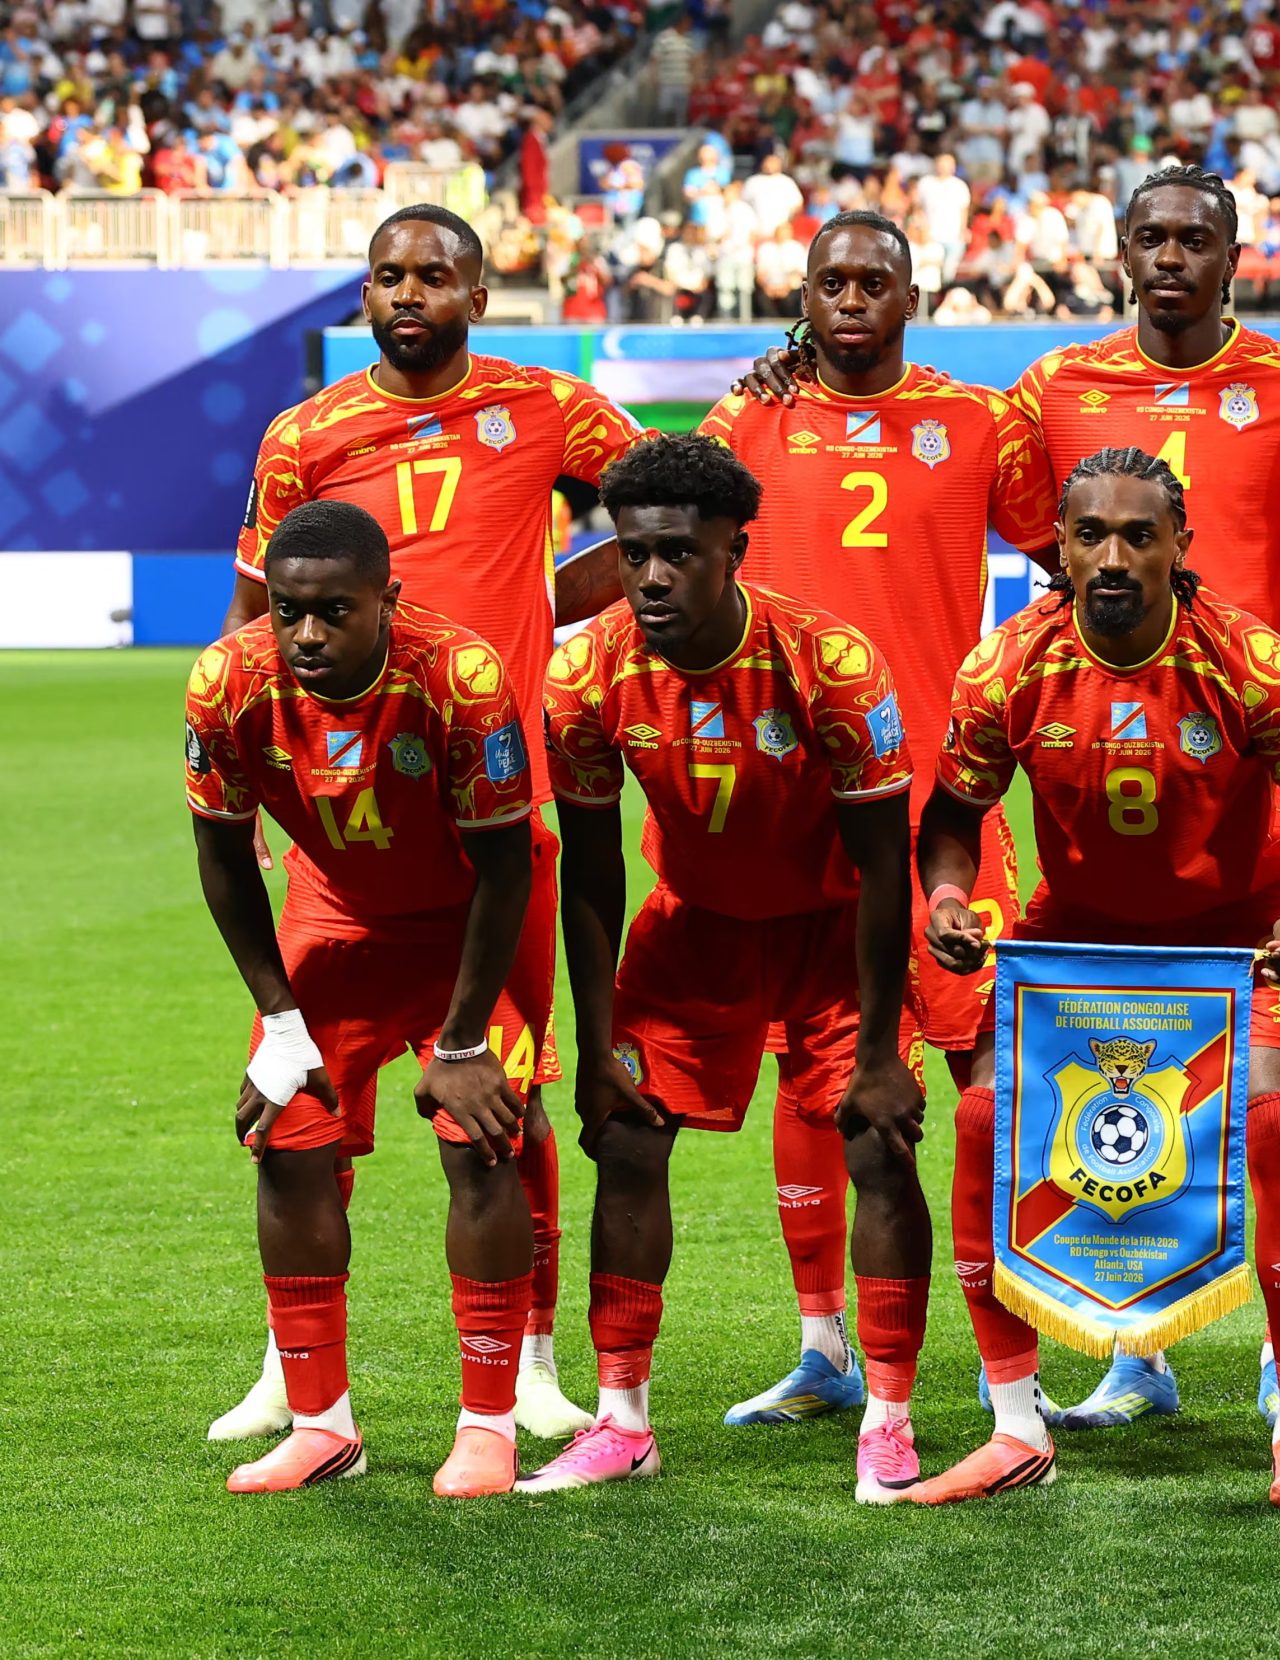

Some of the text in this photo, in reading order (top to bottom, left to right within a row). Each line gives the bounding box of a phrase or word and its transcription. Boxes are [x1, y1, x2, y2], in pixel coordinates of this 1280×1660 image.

[347, 446, 376, 456] umbro
[1155, 431, 1191, 490] 4
[396, 456, 461, 536] 17
[840, 471, 888, 548] 2
[628, 740, 658, 750] umbro
[764, 743, 790, 752] FECOFA
[1041, 740, 1073, 748] umbro
[1188, 745, 1216, 755] FECOFA
[266, 760, 291, 771] umbro
[688, 764, 736, 833] 7
[1106, 767, 1159, 835] 8
[315, 787, 394, 850] 14
[1059, 998, 1189, 1015] FÉDÉRATION CONGOLAISE
[1055, 1016, 1192, 1031] DE FOOTBALL ASSOCIATION
[489, 1023, 535, 1093] 14
[1069, 1168, 1167, 1202] FECOFA
[1054, 1234, 1179, 1249] Coupe du Monde de la FIFA 2026
[1070, 1247, 1082, 1257] RD
[1083, 1247, 1108, 1258] Congo
[1110, 1249, 1119, 1257] vs
[1095, 1260, 1143, 1271] Atlanta, USA
[1095, 1272, 1144, 1282] 27 Juin 2026
[460, 1353, 509, 1366] umbro
